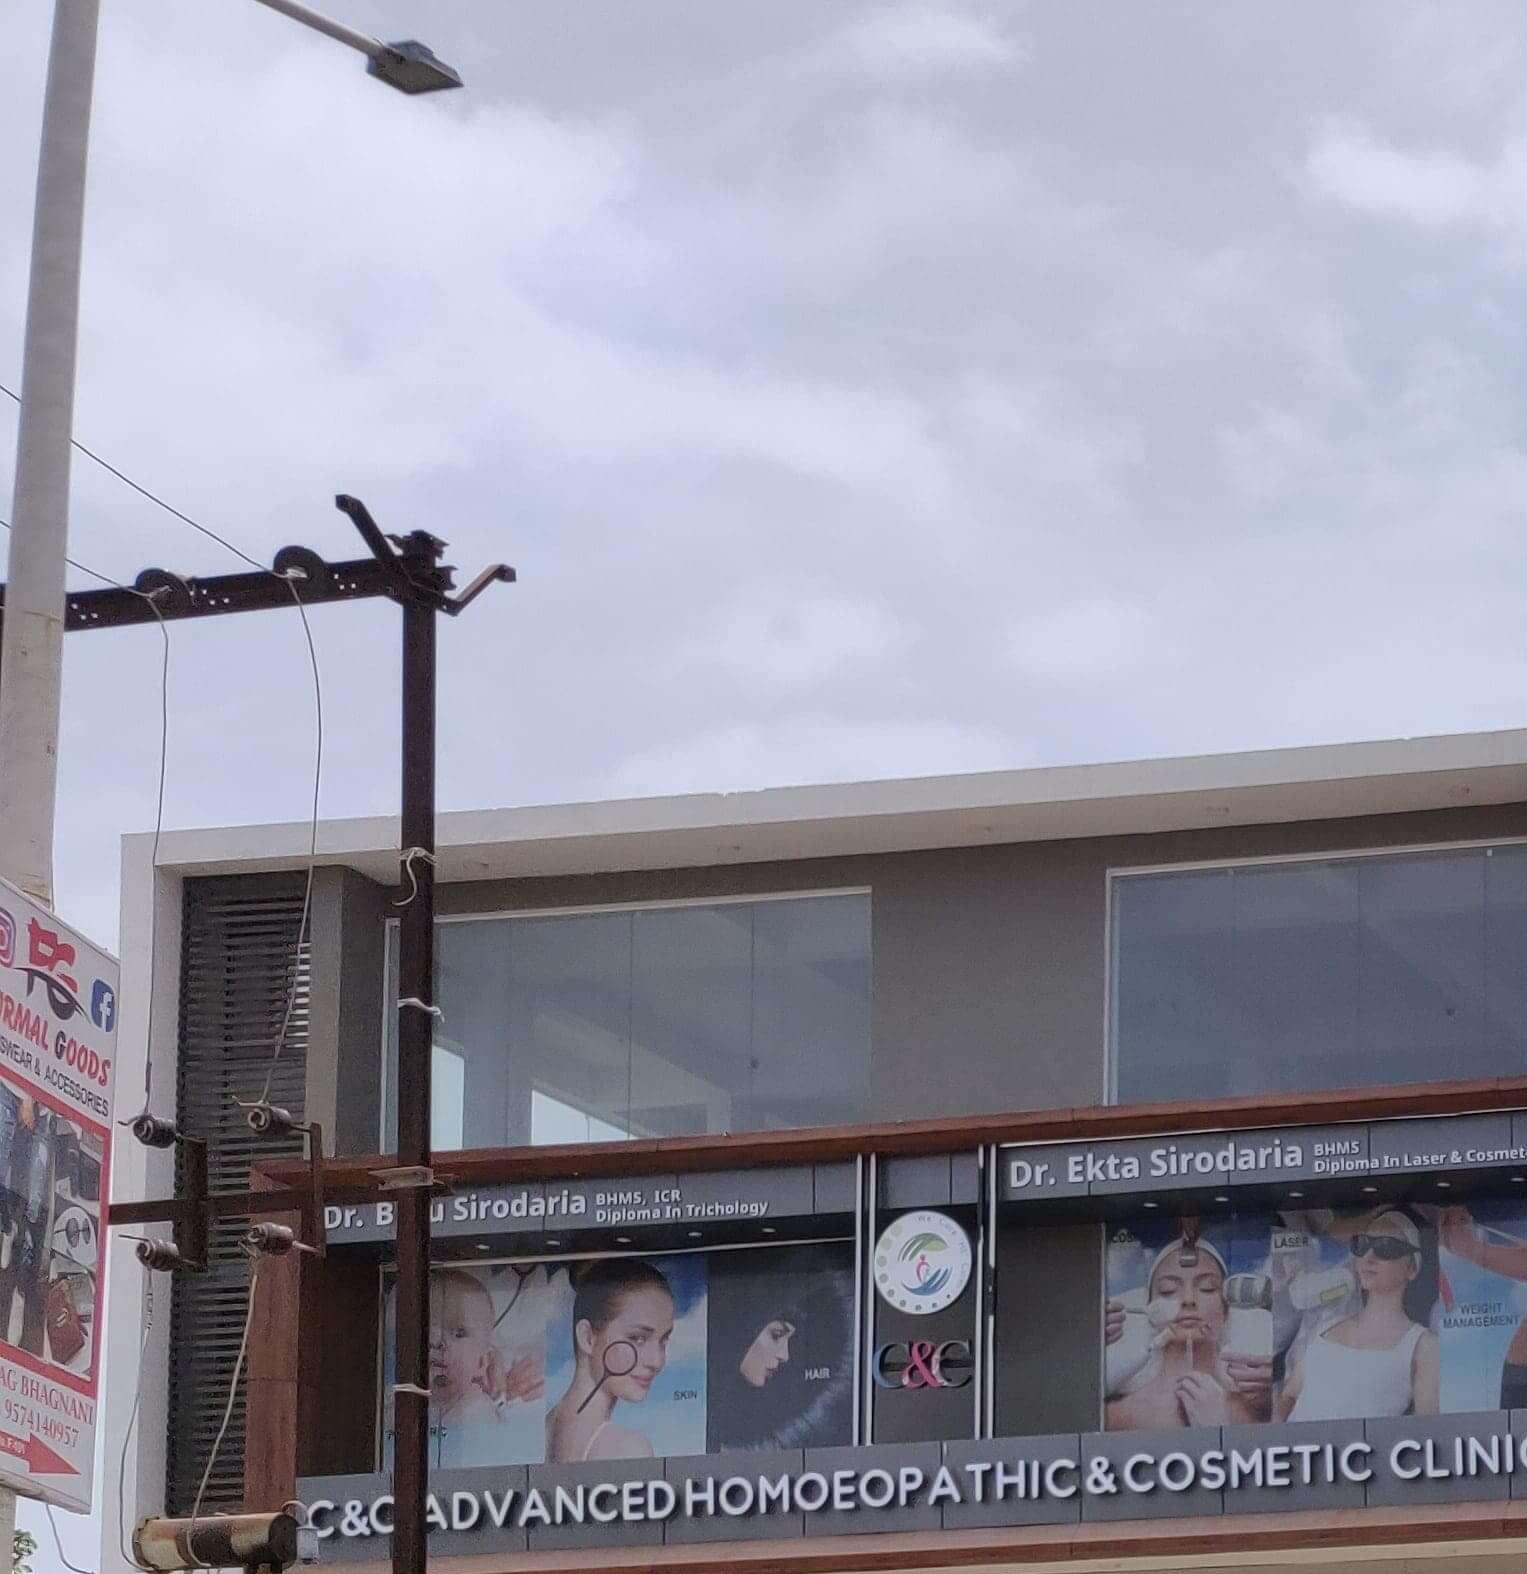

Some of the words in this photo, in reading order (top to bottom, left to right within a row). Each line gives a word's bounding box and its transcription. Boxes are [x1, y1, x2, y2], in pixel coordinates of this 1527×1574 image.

[0, 990, 49, 1051] RMAL
[54, 1030, 112, 1087] GOODS
[44, 1065, 110, 1119] ACCESSORIES
[1313, 1141, 1360, 1158] BHMS
[1313, 1155, 1379, 1174] Diploma
[1383, 1154, 1400, 1169] In
[1403, 1151, 1448, 1168] Laser
[1450, 1149, 1463, 1164] &
[1009, 1158, 1056, 1189] Dr.
[1067, 1148, 1141, 1184] Ekta
[1149, 1138, 1303, 1178] Sirodaria
[323, 1204, 364, 1230] Dr.
[453, 1189, 588, 1222] Sirodaria
[595, 1192, 647, 1209] BHMS,
[654, 1189, 682, 1205] ICR
[595, 1207, 662, 1226] Diploma
[665, 1205, 682, 1219] In
[685, 1198, 769, 1220] Trichology
[1442, 1313, 1522, 1330] MANAGEMENT
[1460, 1302, 1502, 1316] WEIGHT
[804, 1367, 830, 1381] HAIR
[21, 1375, 94, 1426] BHAGNANI
[673, 1389, 699, 1401] SKIN
[426, 1479, 676, 1531] ADVANCED
[688, 1458, 1078, 1518] HOMOEOPATHIC
